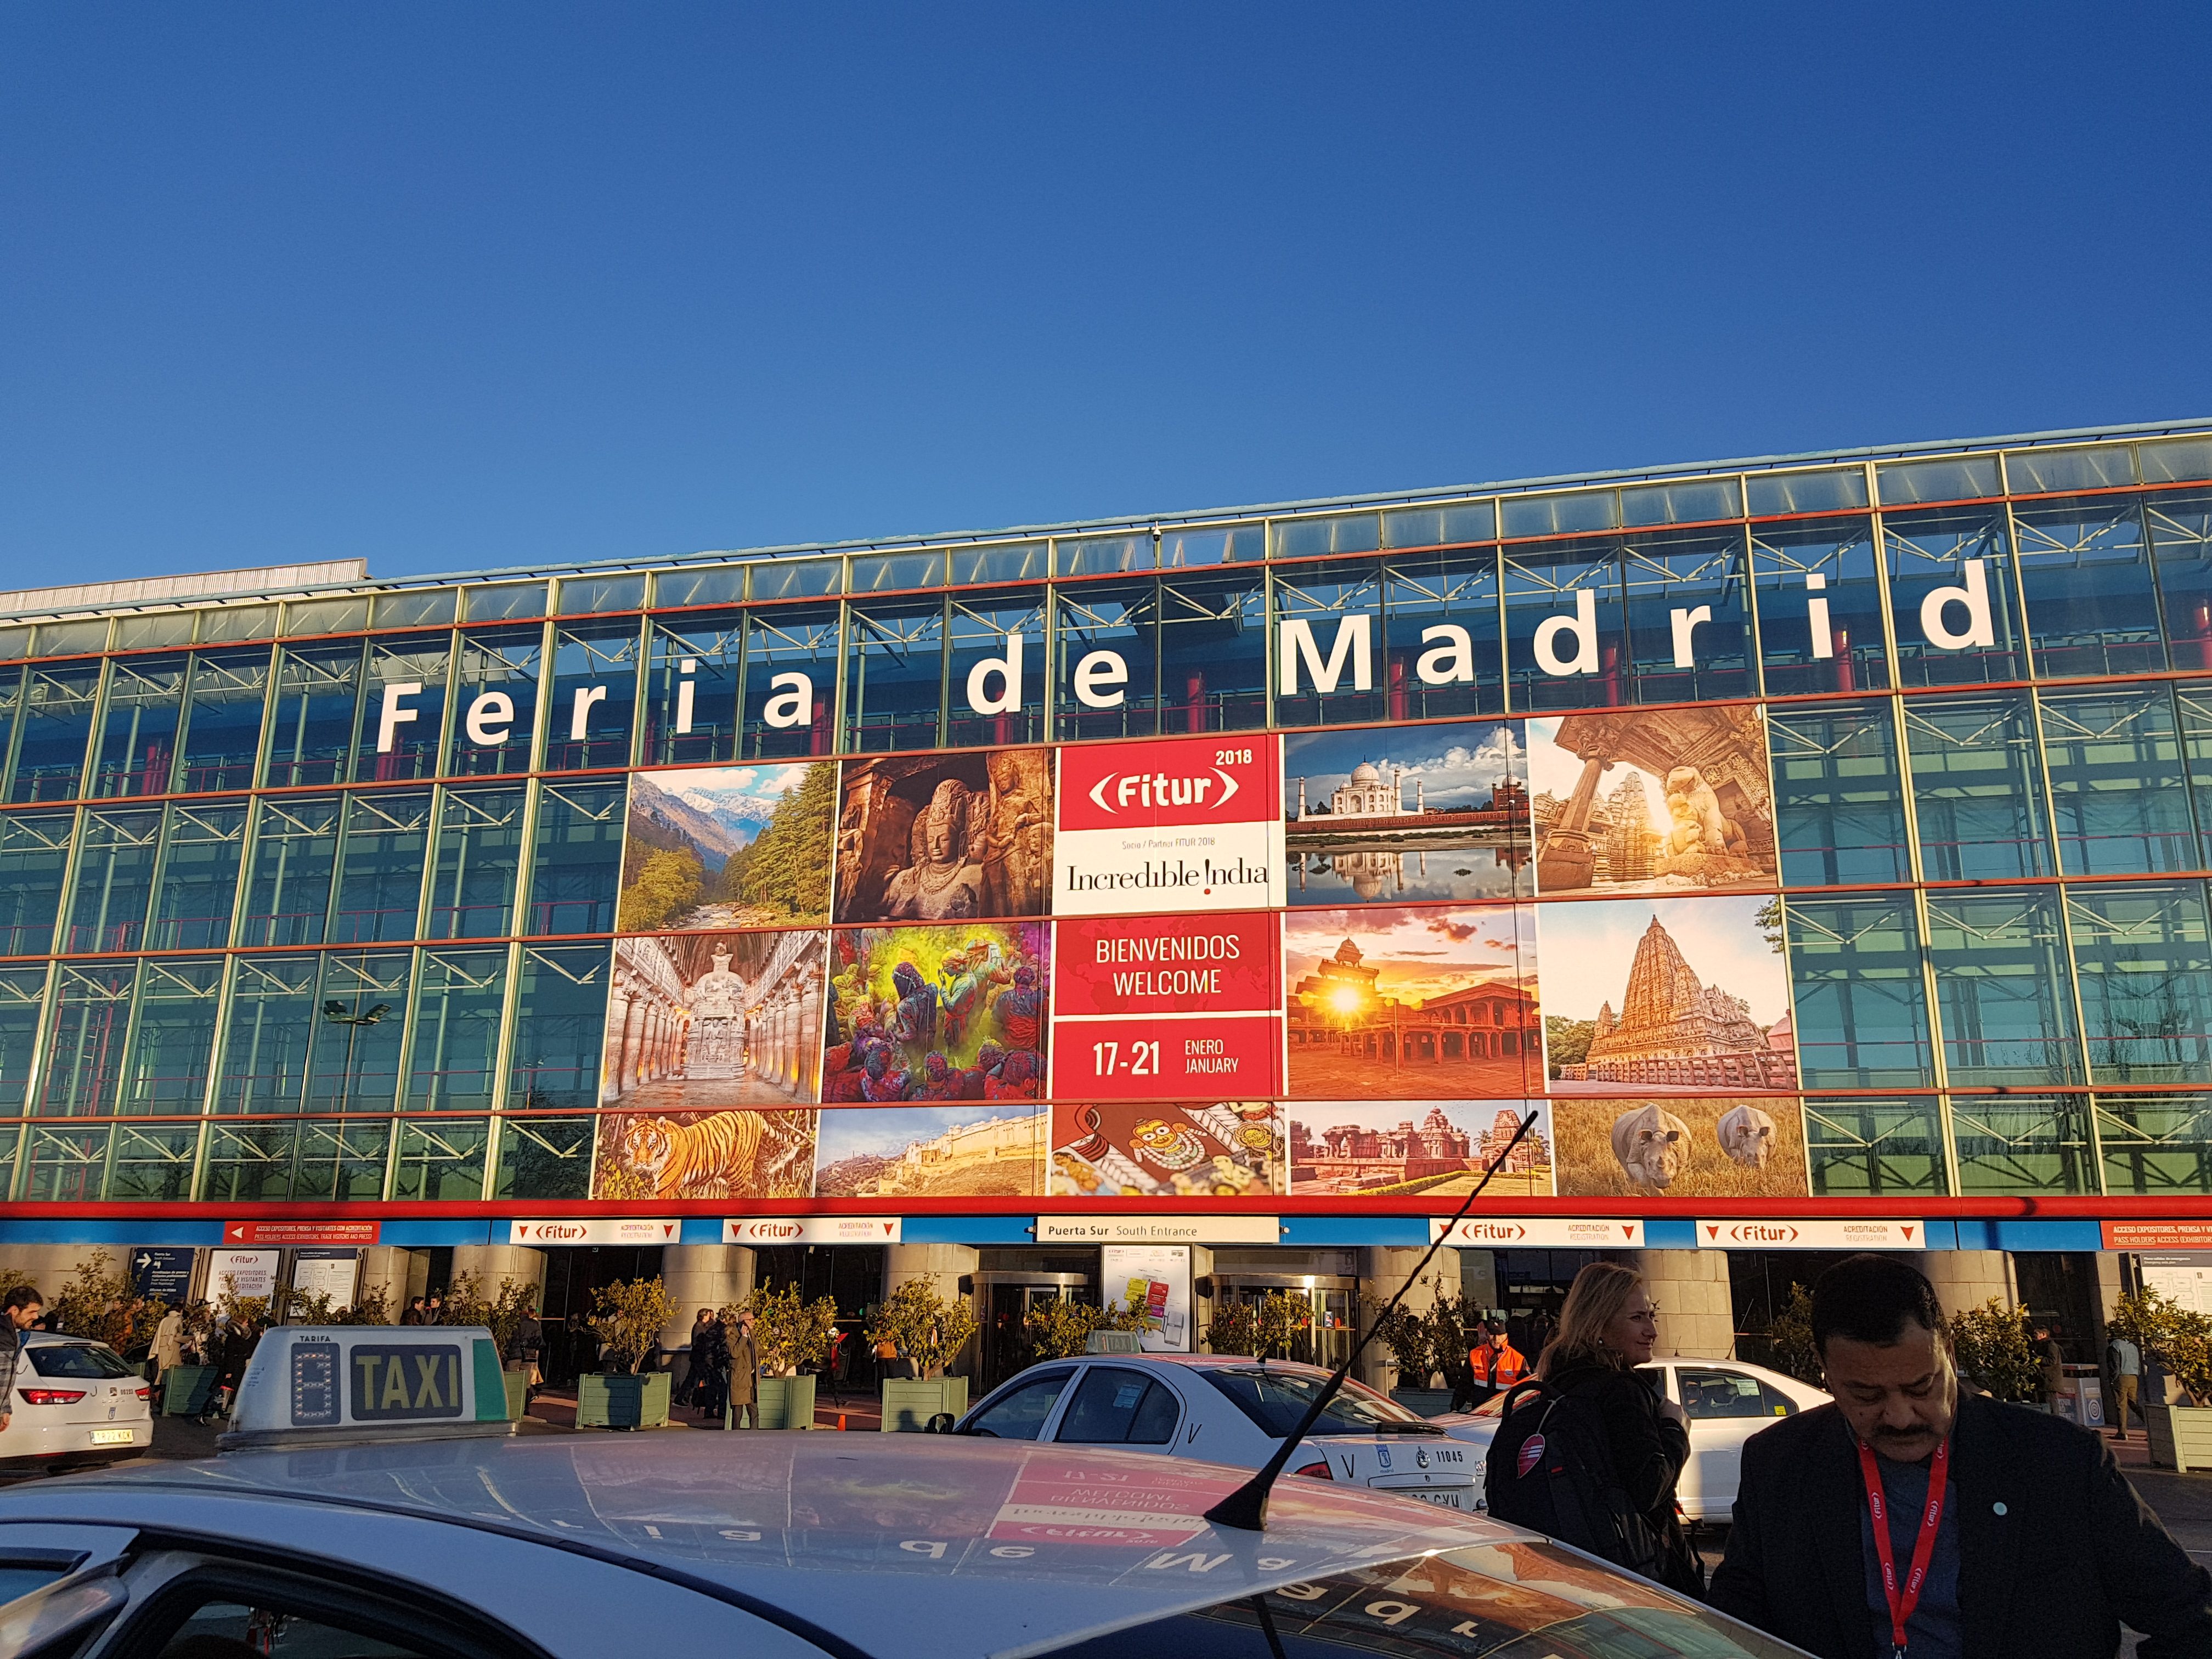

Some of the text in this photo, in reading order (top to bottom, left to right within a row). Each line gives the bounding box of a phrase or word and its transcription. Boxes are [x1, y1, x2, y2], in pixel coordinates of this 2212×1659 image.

[377, 558, 1995, 753] Feria de Madrid
[1215, 749, 1252, 765] 2018
[1117, 772, 1212, 808] Fitur
[1122, 841, 1141, 850] Socio
[1148, 839, 1173, 848] Partner
[1175, 838, 1196, 848] FITUR
[1198, 837, 1215, 847] 2018
[1067, 860, 1200, 891] Incredible
[1096, 934, 1240, 963] BIENVENIDOS
[1113, 969, 1222, 996] WELCOME
[1185, 1039, 1224, 1056] ENERO
[1093, 1041, 1160, 1076] 17-21
[1185, 1057, 1239, 1074] JANUARY
[546, 1225, 578, 1239] Fitur
[760, 1223, 794, 1237] Fitur
[1048, 1226, 1198, 1237] Puerta Sur South Entrance
[1474, 1224, 1514, 1239] Fitur
[1743, 1226, 1786, 1241] Fitur
[356, 1355, 459, 1410] TAXI
[1188, 1423, 1202, 1444] V
[1436, 1451, 1463, 1463] 11045
[1341, 1454, 1355, 1479] V
